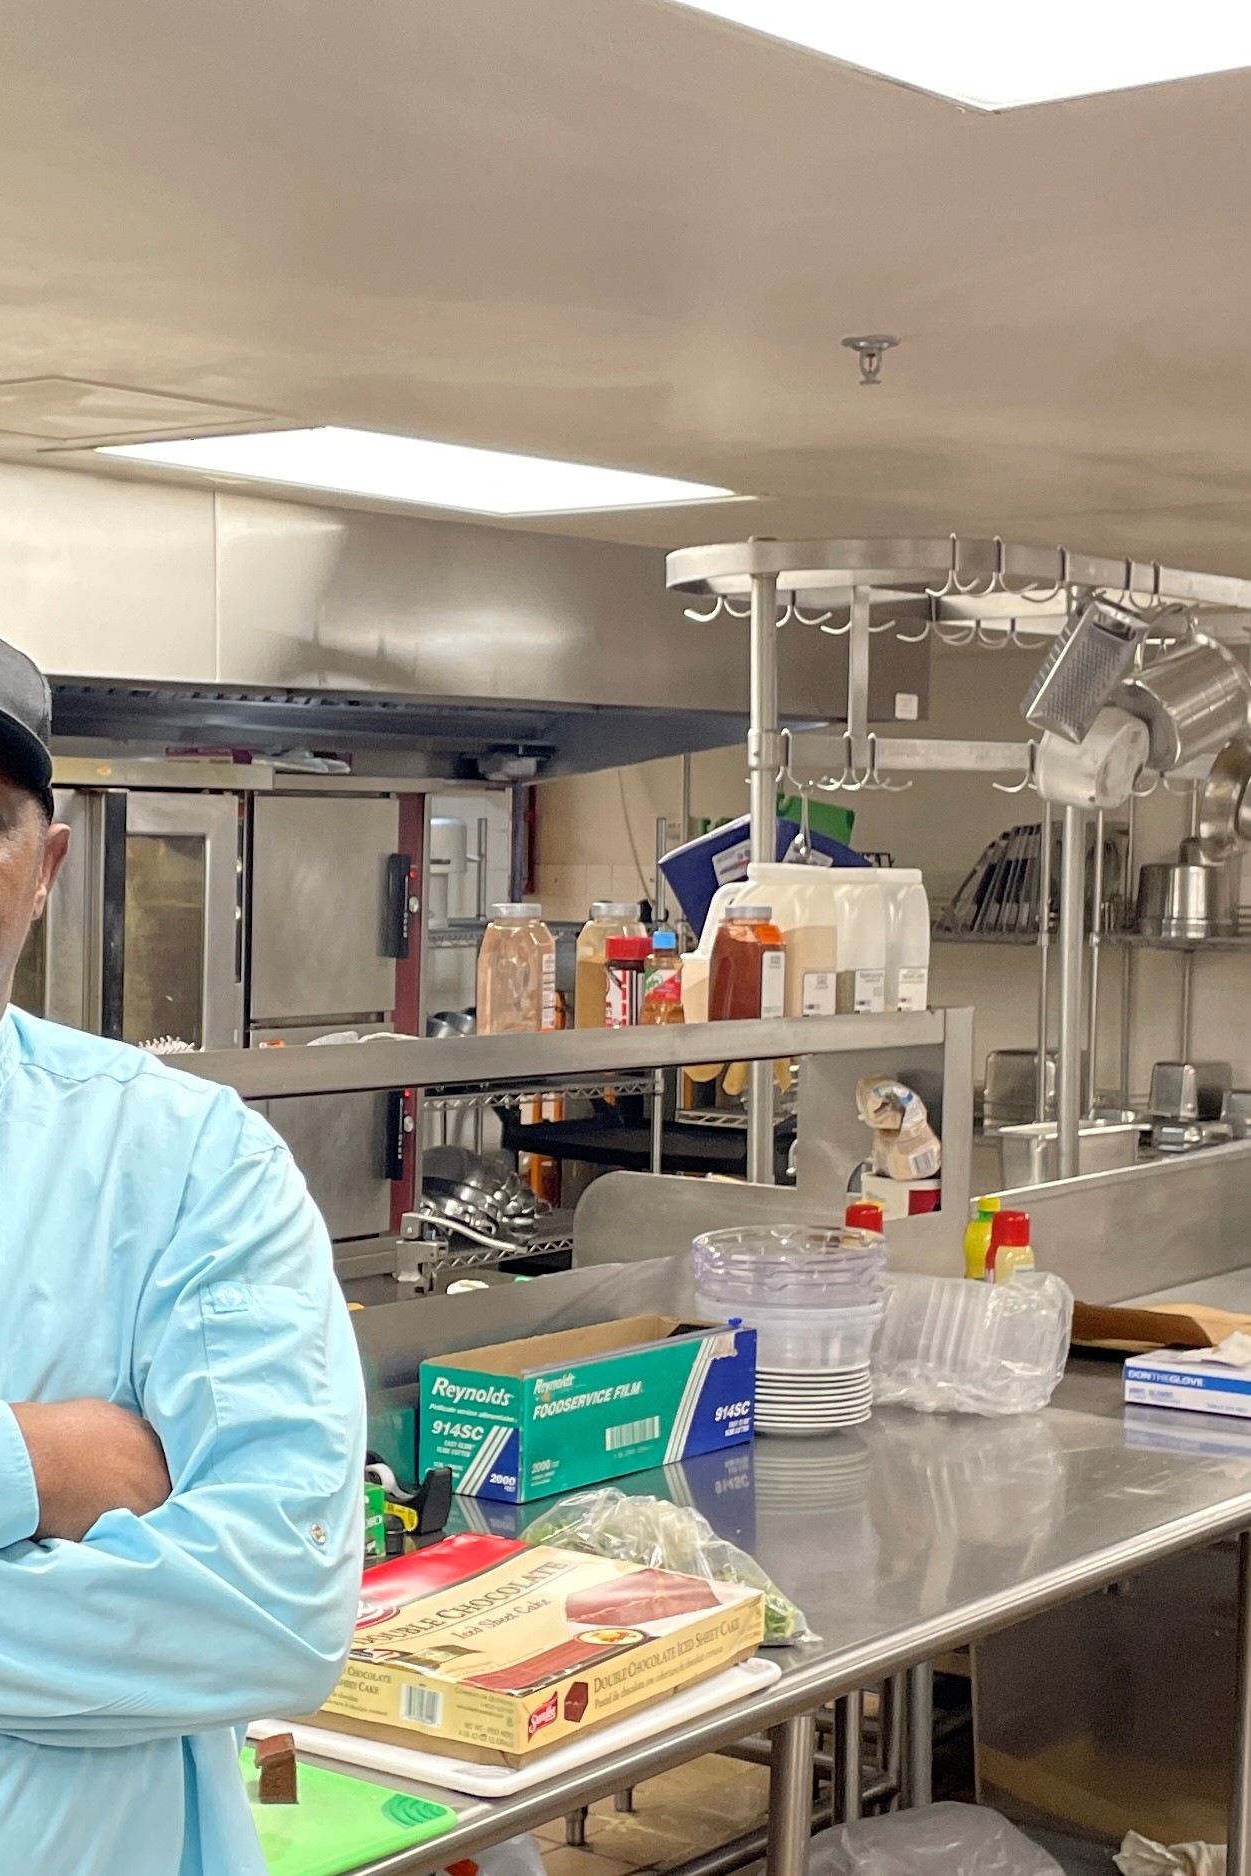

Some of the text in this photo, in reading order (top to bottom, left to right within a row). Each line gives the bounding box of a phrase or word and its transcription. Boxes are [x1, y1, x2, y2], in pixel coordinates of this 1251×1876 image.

[431, 1376, 512, 1407] Reynolds
[532, 1387, 614, 1420] FOODSERVICE
[613, 1380, 643, 1400] FILM
[714, 1400, 751, 1422] 914SC
[431, 1420, 485, 1441] 914SC
[490, 1473, 517, 1486] 2000
[435, 1561, 569, 1620] CHOCOLATE
[347, 1665, 392, 1684] CHOCOLATE
[594, 1670, 628, 1694] DOUBLE
[627, 1646, 677, 1678] CHOCOLATE
[338, 1678, 358, 1690] HEET
